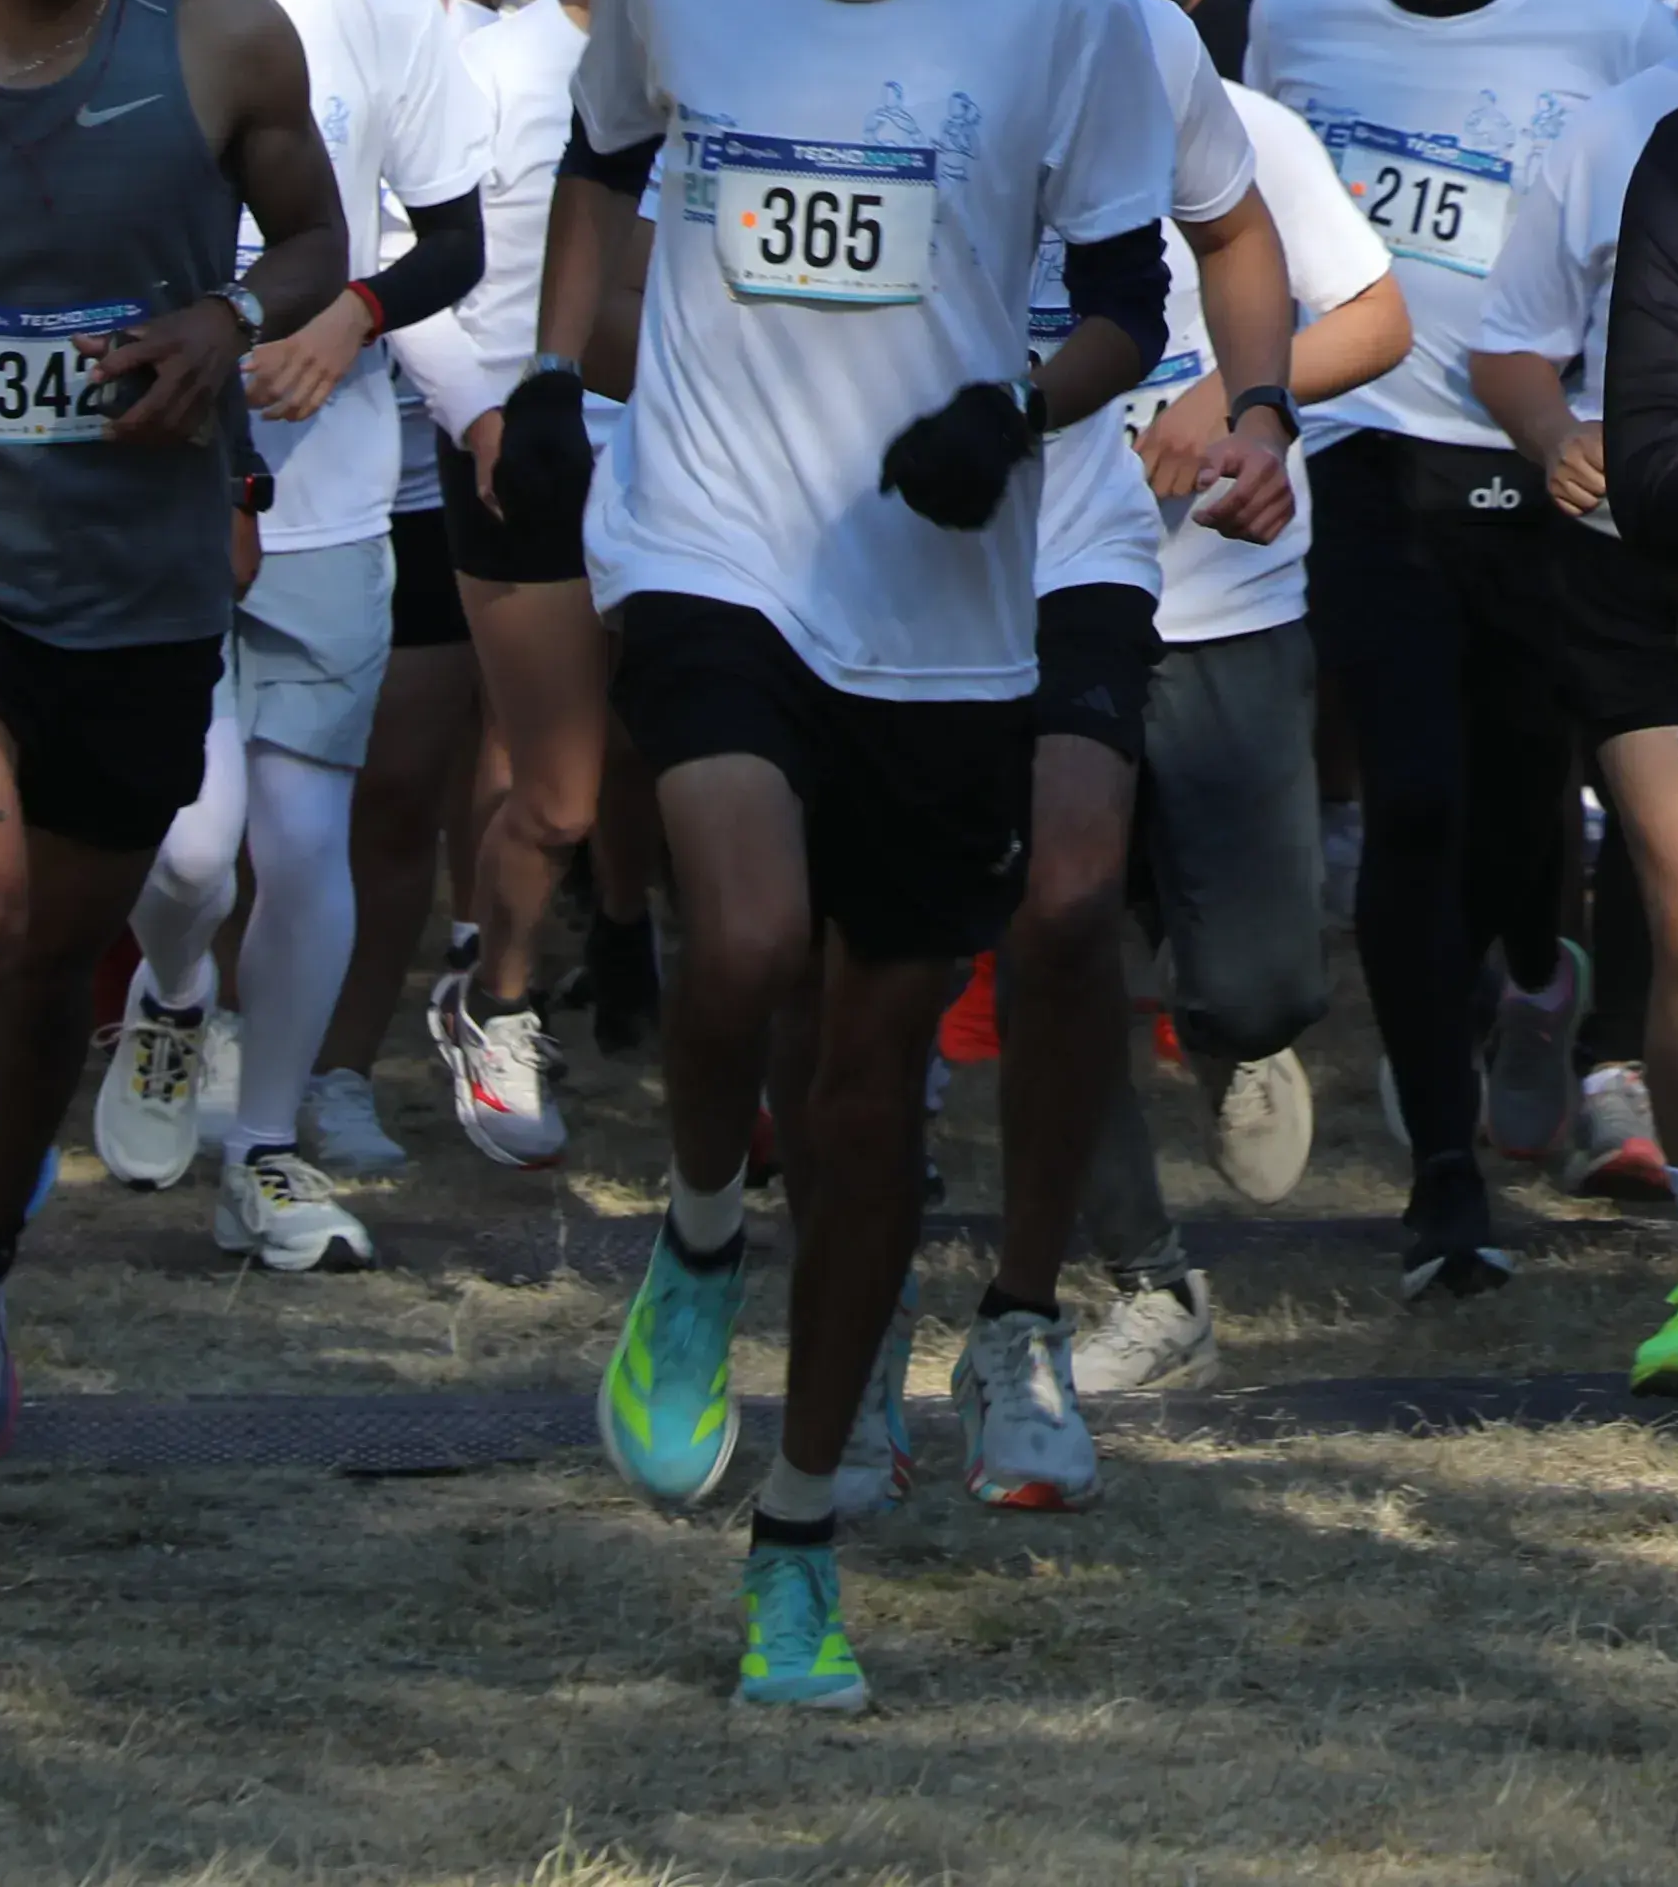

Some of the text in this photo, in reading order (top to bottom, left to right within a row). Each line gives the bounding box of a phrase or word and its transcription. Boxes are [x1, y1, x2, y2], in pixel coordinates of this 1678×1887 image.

[759, 187, 884, 272] 365
[1368, 165, 1468, 242] 215
[1468, 476, 1521, 509] alo
